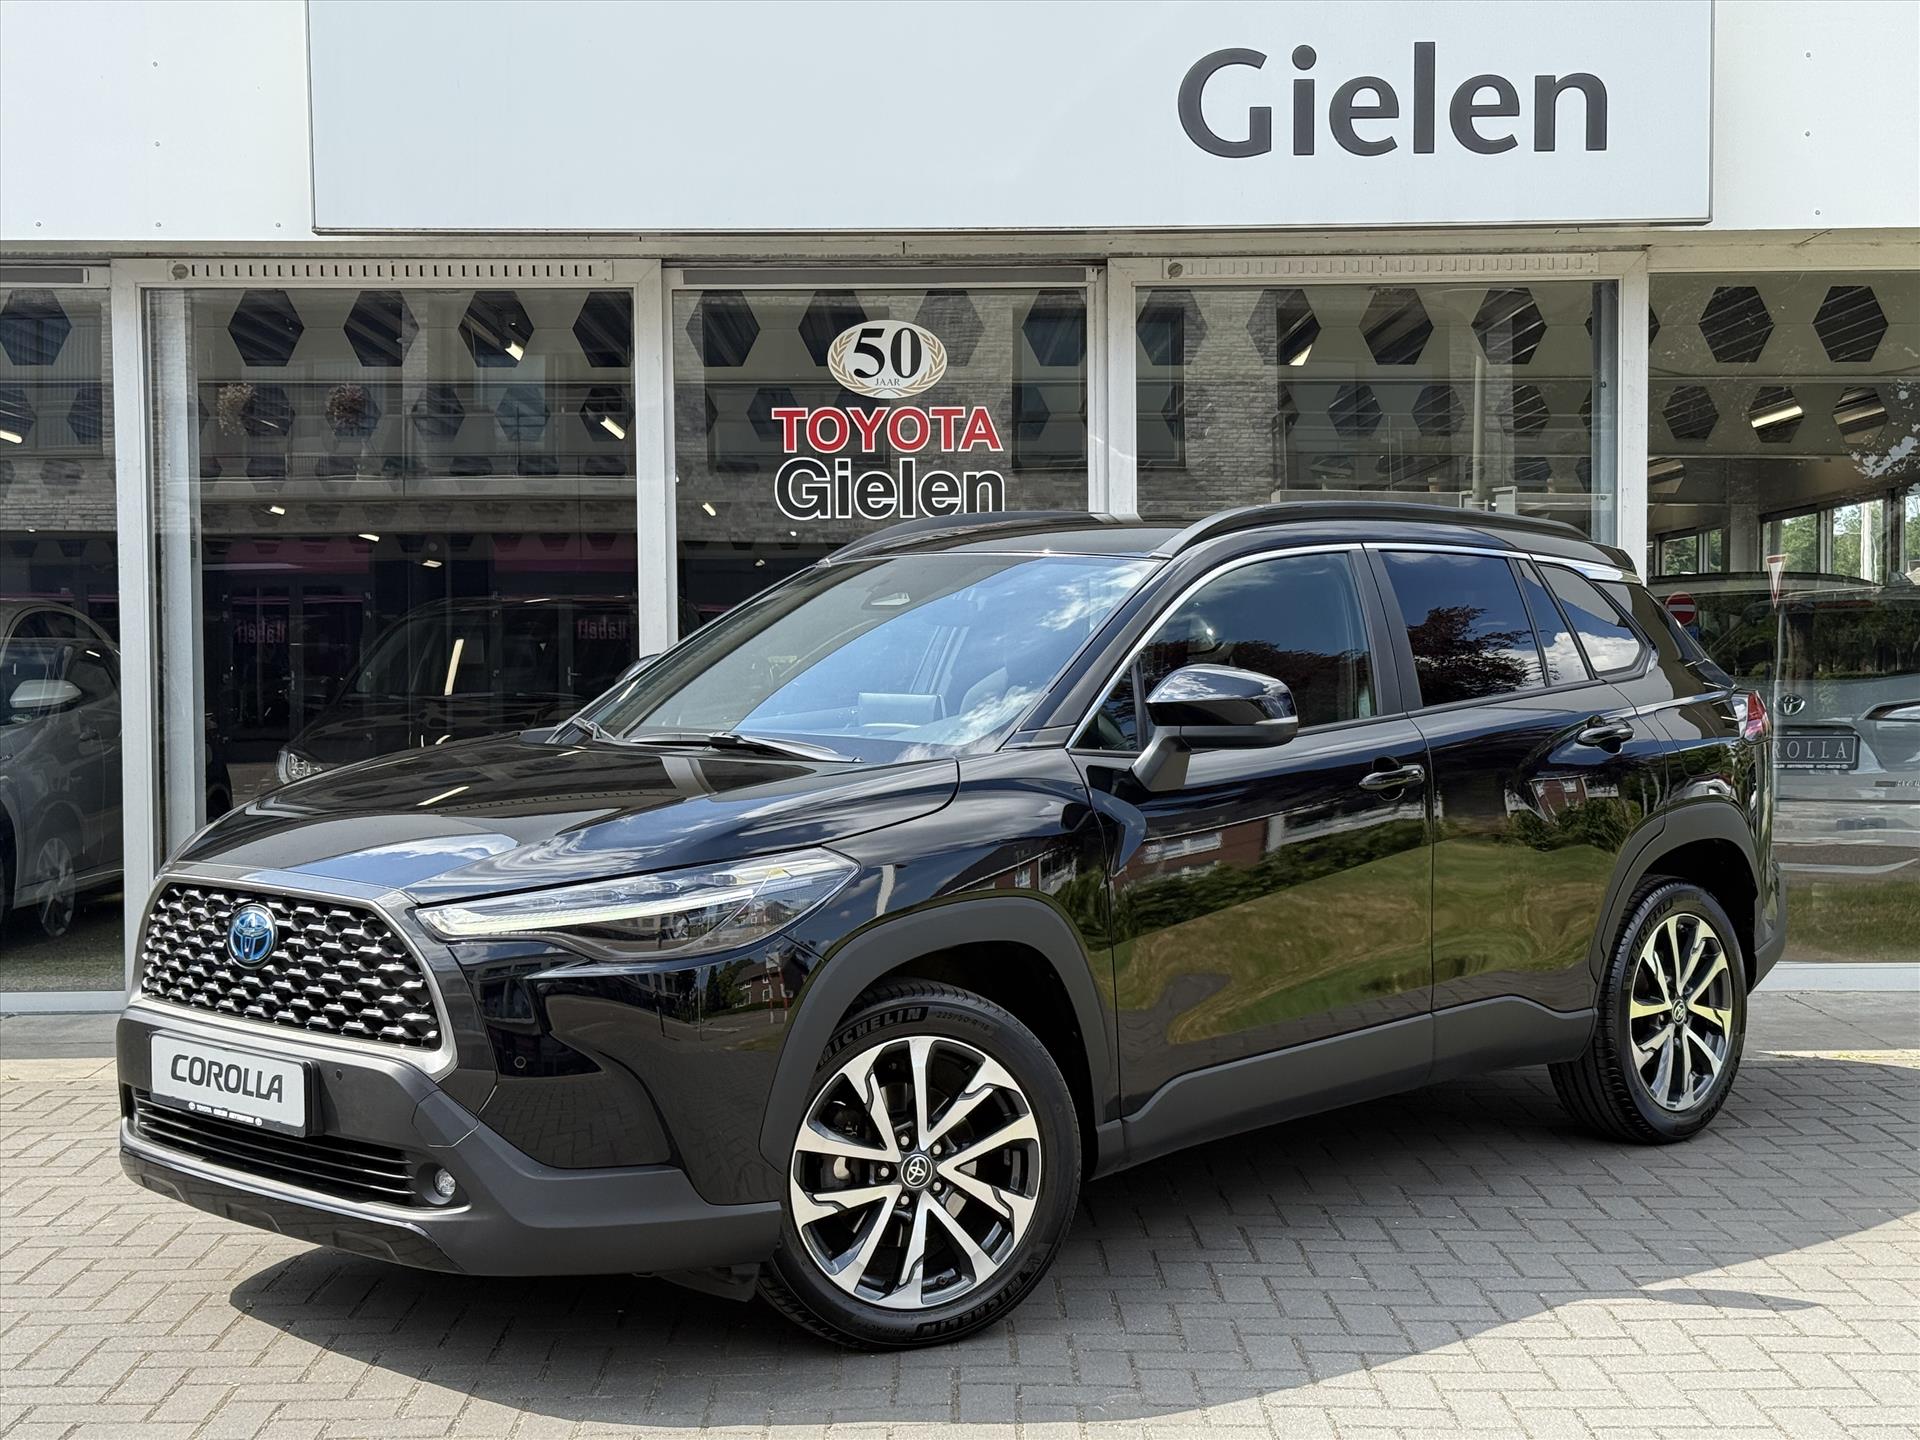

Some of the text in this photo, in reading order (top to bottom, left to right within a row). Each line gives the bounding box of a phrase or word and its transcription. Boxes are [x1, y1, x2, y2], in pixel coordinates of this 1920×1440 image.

[1177, 41, 1608, 158] Gielen
[853, 327, 922, 379] 50
[874, 377, 900, 387] JAAR
[771, 406, 1004, 454] TOYOTA
[774, 457, 1005, 520] Gielen
[819, 1007, 922, 1065] MICHELIN
[171, 1054, 283, 1104] COROLLA
